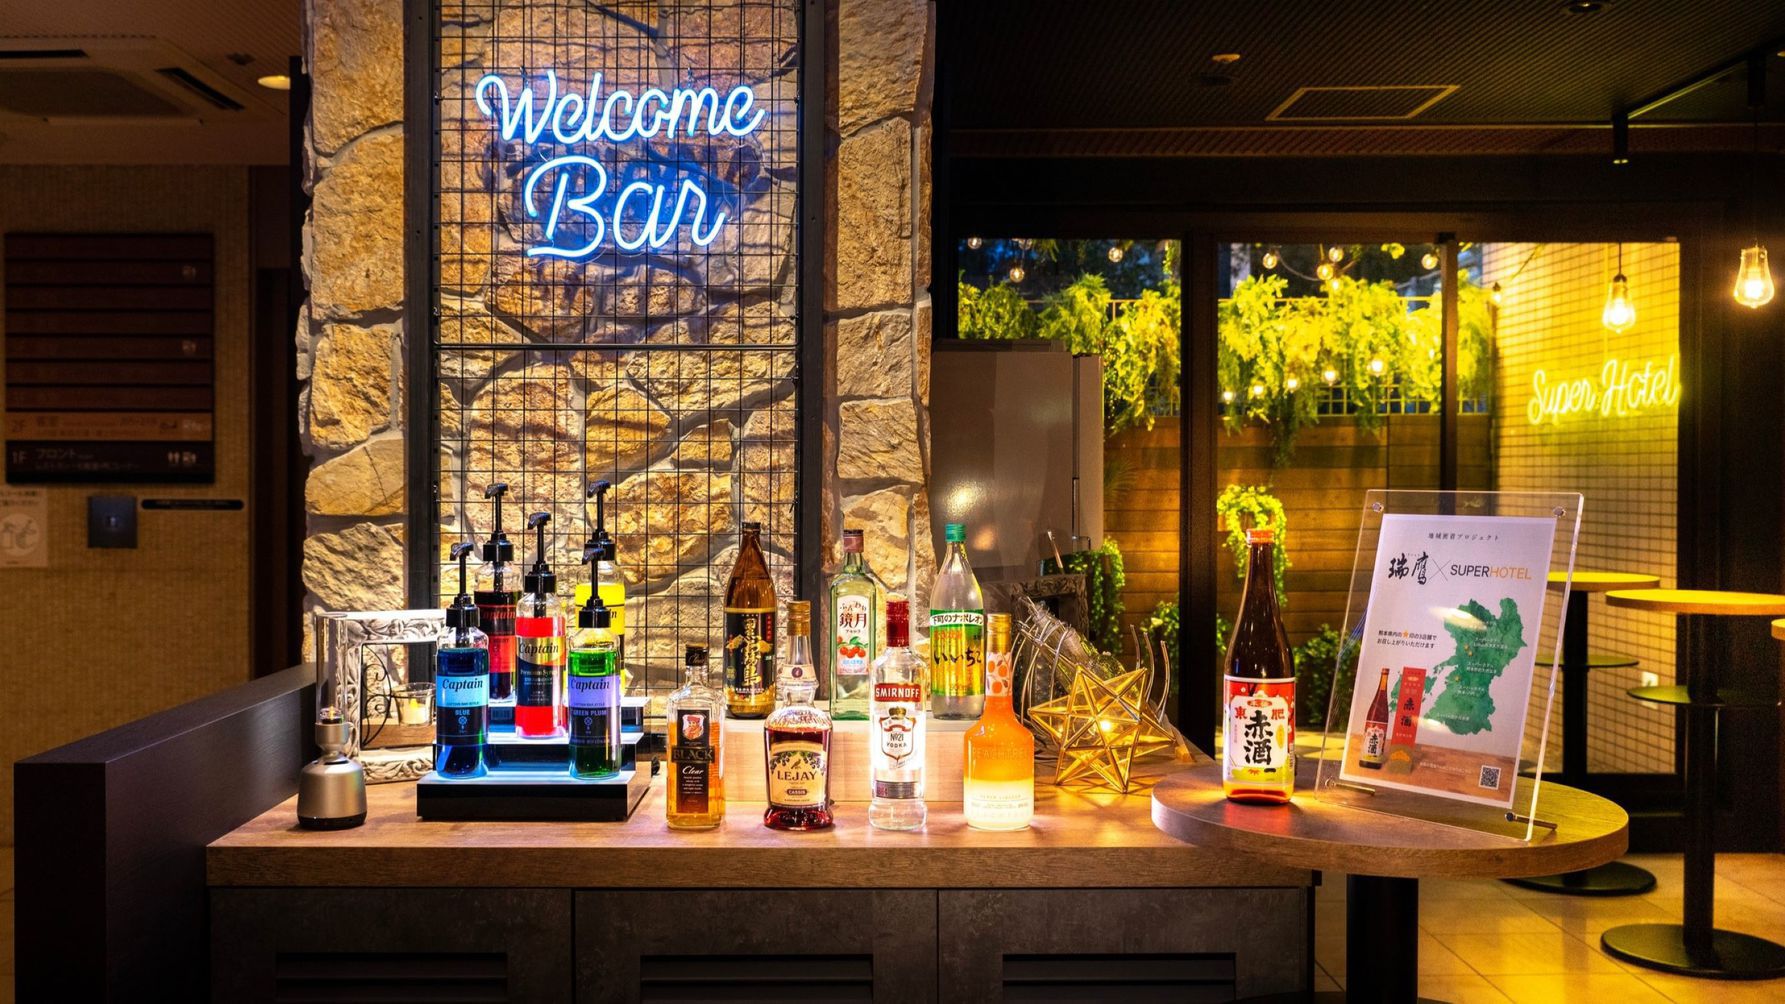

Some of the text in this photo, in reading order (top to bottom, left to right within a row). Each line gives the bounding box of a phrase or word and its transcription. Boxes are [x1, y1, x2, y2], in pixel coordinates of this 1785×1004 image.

[475, 70, 769, 144] Welcome
[524, 155, 726, 258] Bar
[1527, 354, 1681, 426] Super Hotel
[1450, 564, 1532, 581] SUPERHOTEL
[839, 612, 867, 628] 鏡月
[519, 642, 559, 657] Captain
[933, 645, 982, 667] いいちこ
[442, 678, 483, 692] Captain
[571, 678, 610, 692] Captain
[875, 687, 920, 698] SMIRNOFF
[1244, 709, 1273, 766] 赤酒
[672, 749, 713, 760] BLACK
[682, 765, 704, 775] Clear
[777, 770, 818, 781] LEJAY
